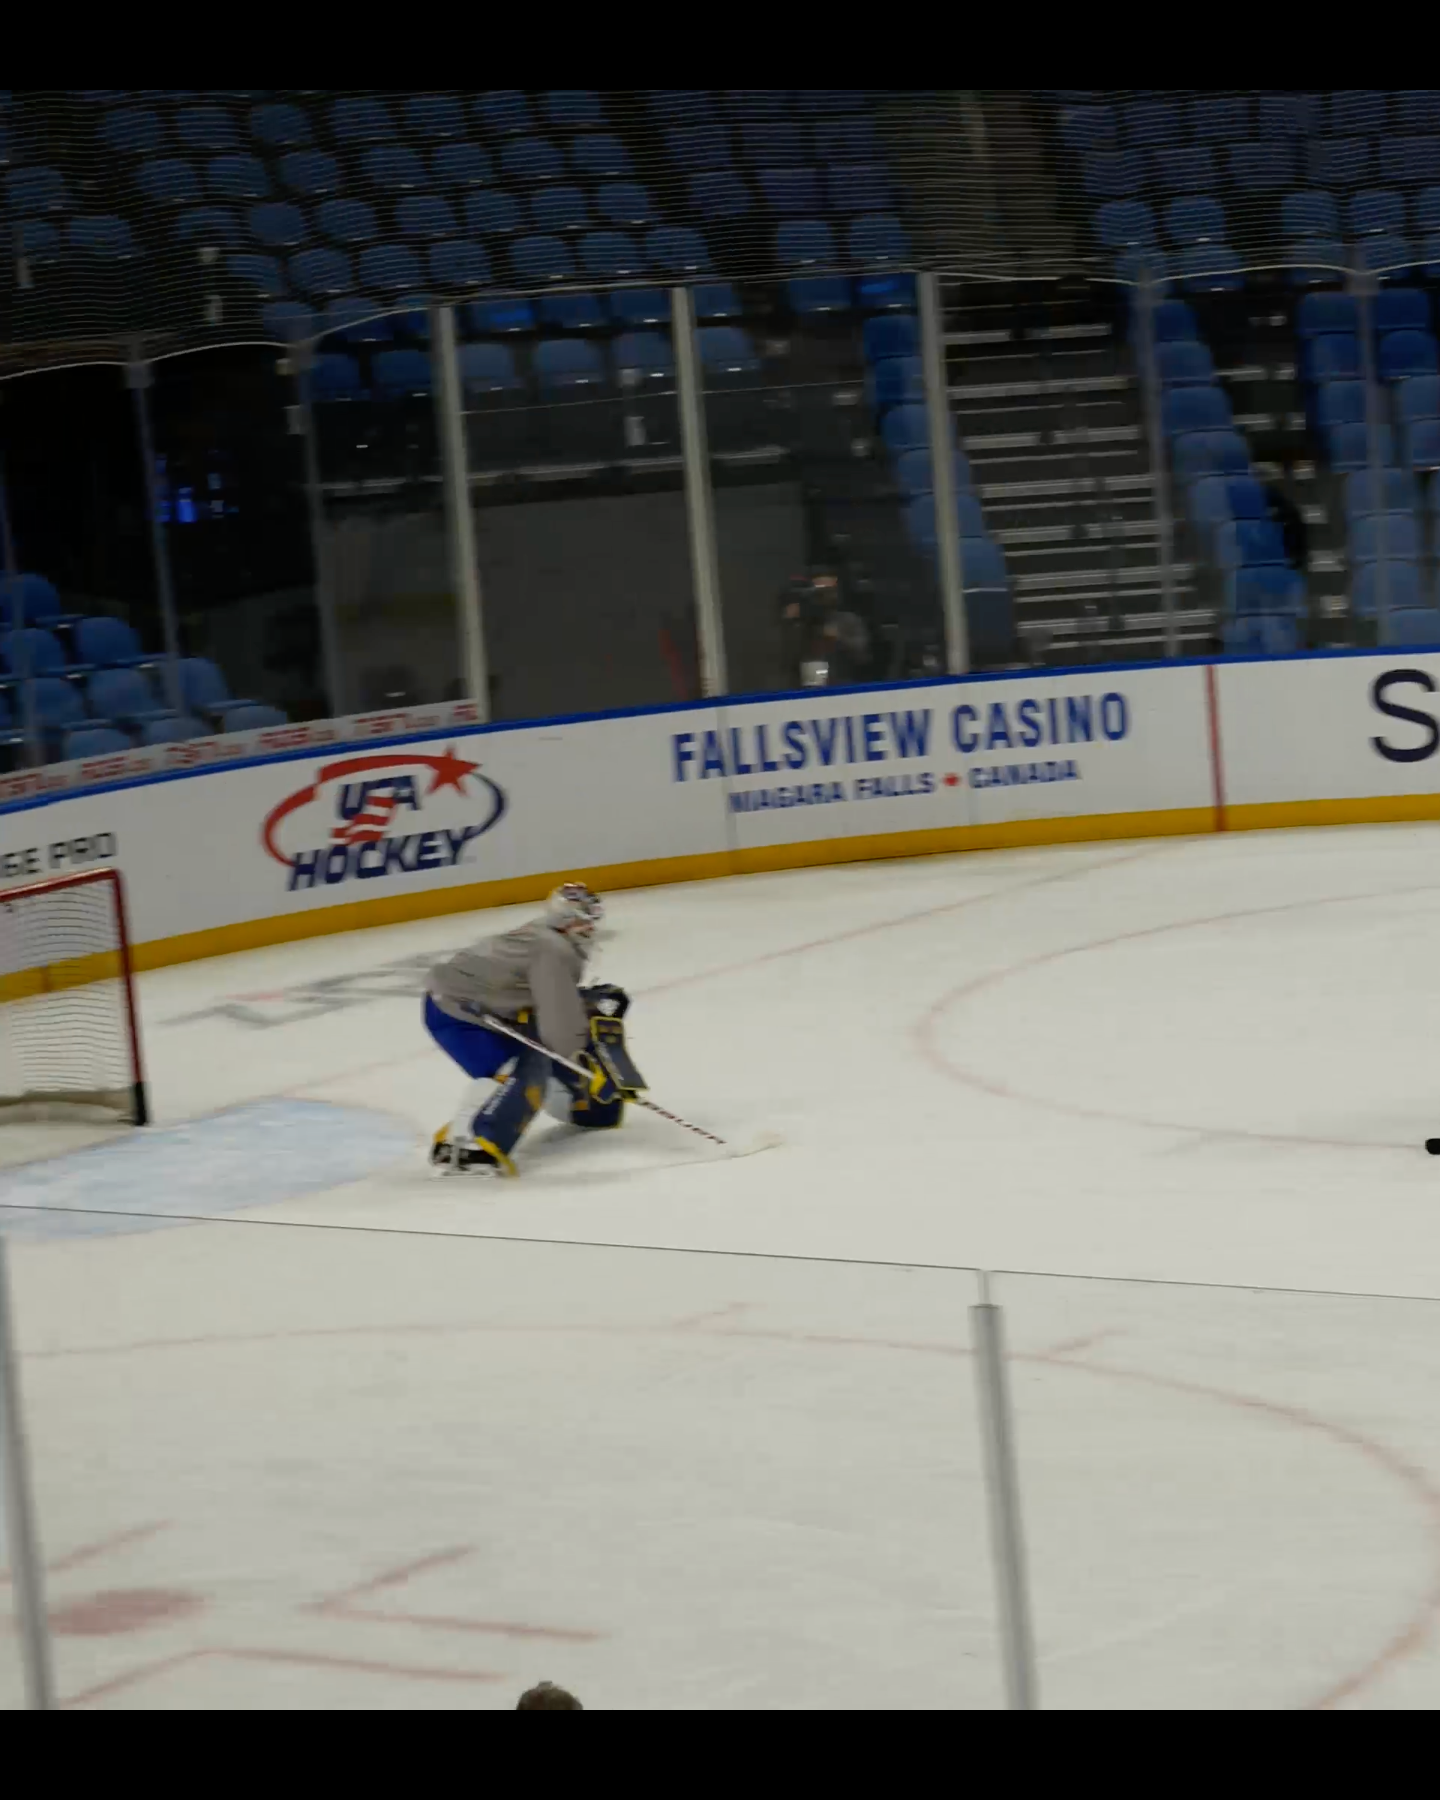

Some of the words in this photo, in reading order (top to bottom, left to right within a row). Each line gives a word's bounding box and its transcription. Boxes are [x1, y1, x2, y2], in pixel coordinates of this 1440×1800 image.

[671, 709, 934, 783] FALLSVIEW
[952, 691, 1129, 754] CASINO
[331, 774, 422, 846] USA
[728, 781, 847, 813] NIAGARA
[855, 772, 936, 799] FALLS
[968, 759, 1081, 788] CANADA
[48, 832, 117, 869] PRO
[288, 826, 479, 891] HOCKEY
